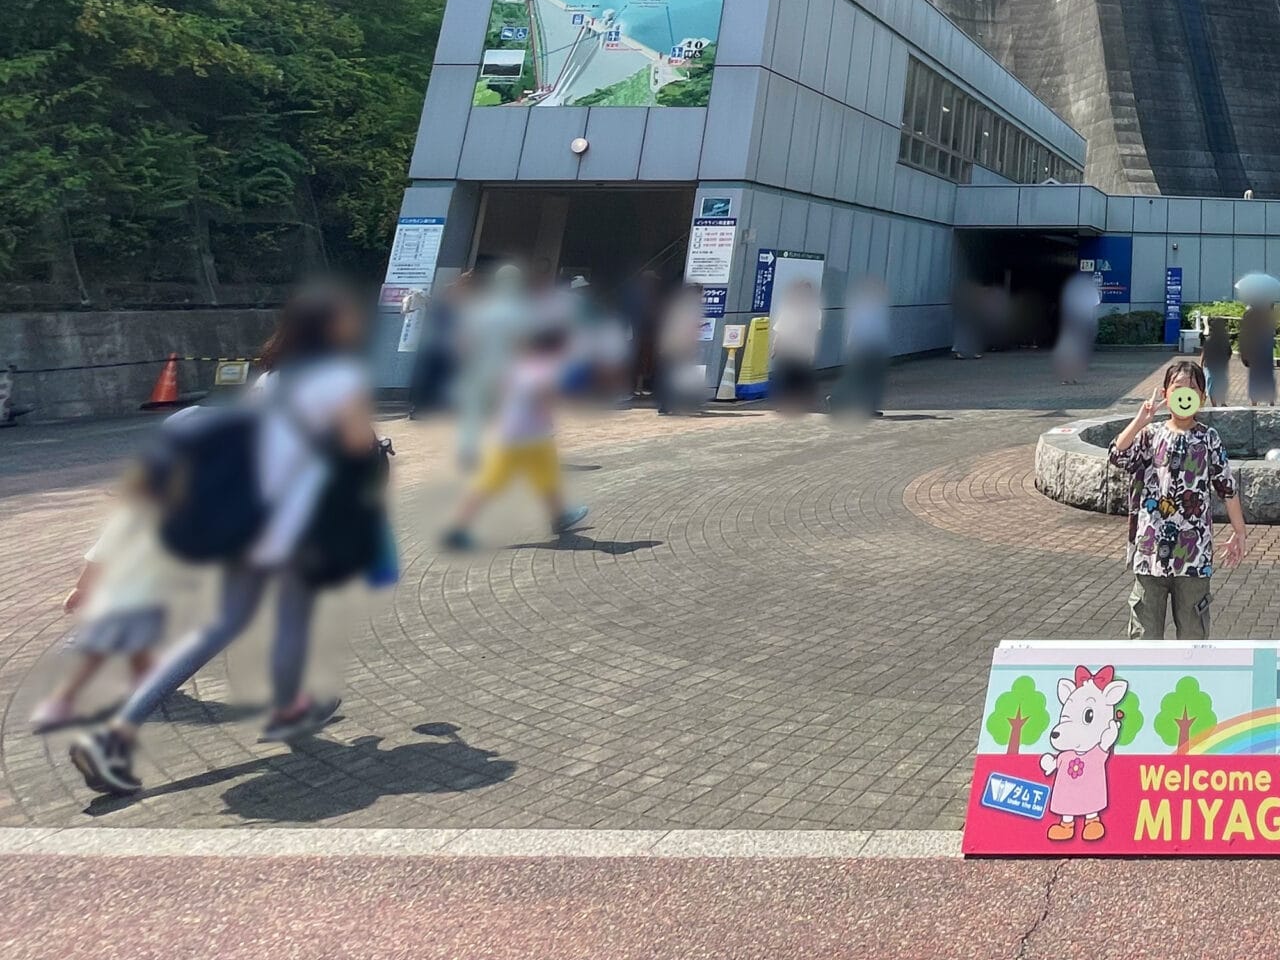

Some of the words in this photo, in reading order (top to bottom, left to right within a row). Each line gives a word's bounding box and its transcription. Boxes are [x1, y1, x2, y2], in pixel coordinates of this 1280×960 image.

[1139, 764, 1272, 792] Welcome
[1012, 785, 1043, 804] ダム下
